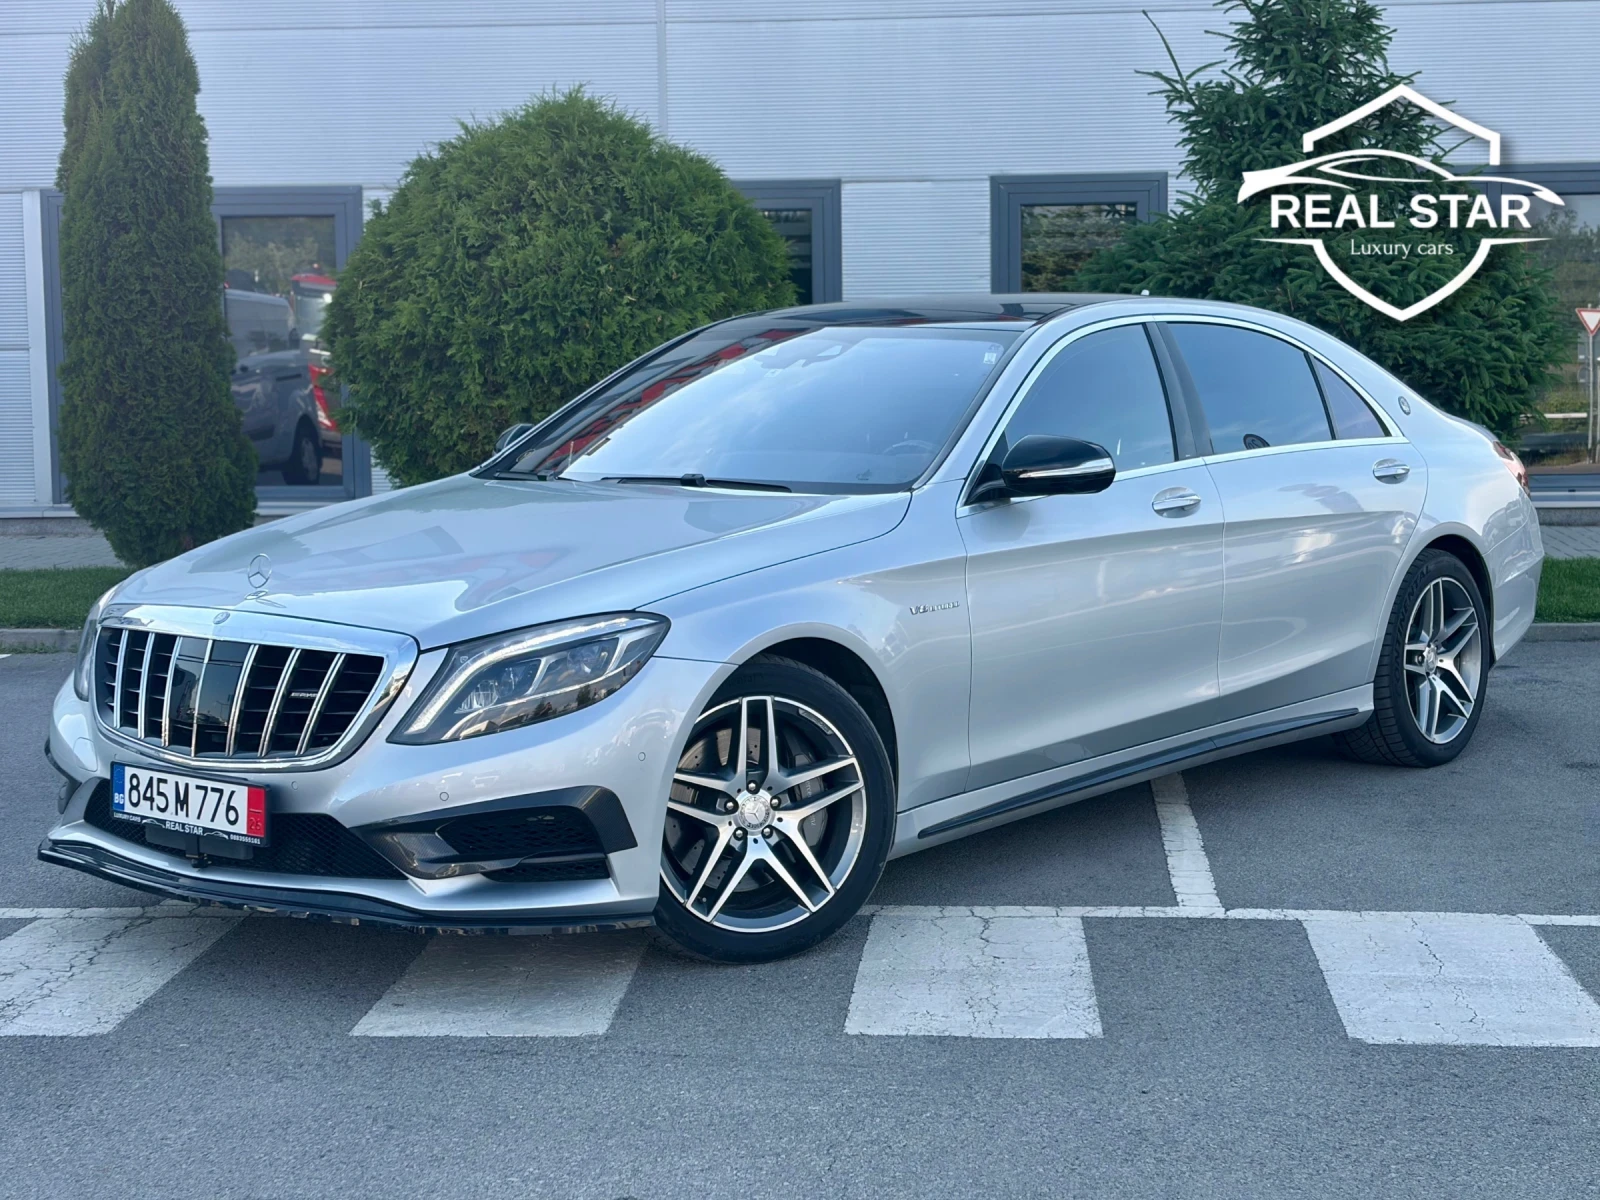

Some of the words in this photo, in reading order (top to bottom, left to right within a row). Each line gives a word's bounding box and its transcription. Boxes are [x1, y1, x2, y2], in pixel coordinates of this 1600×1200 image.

[114, 793, 125, 805] BG
[165, 821, 184, 833] REAL
[185, 825, 204, 836] STAR
